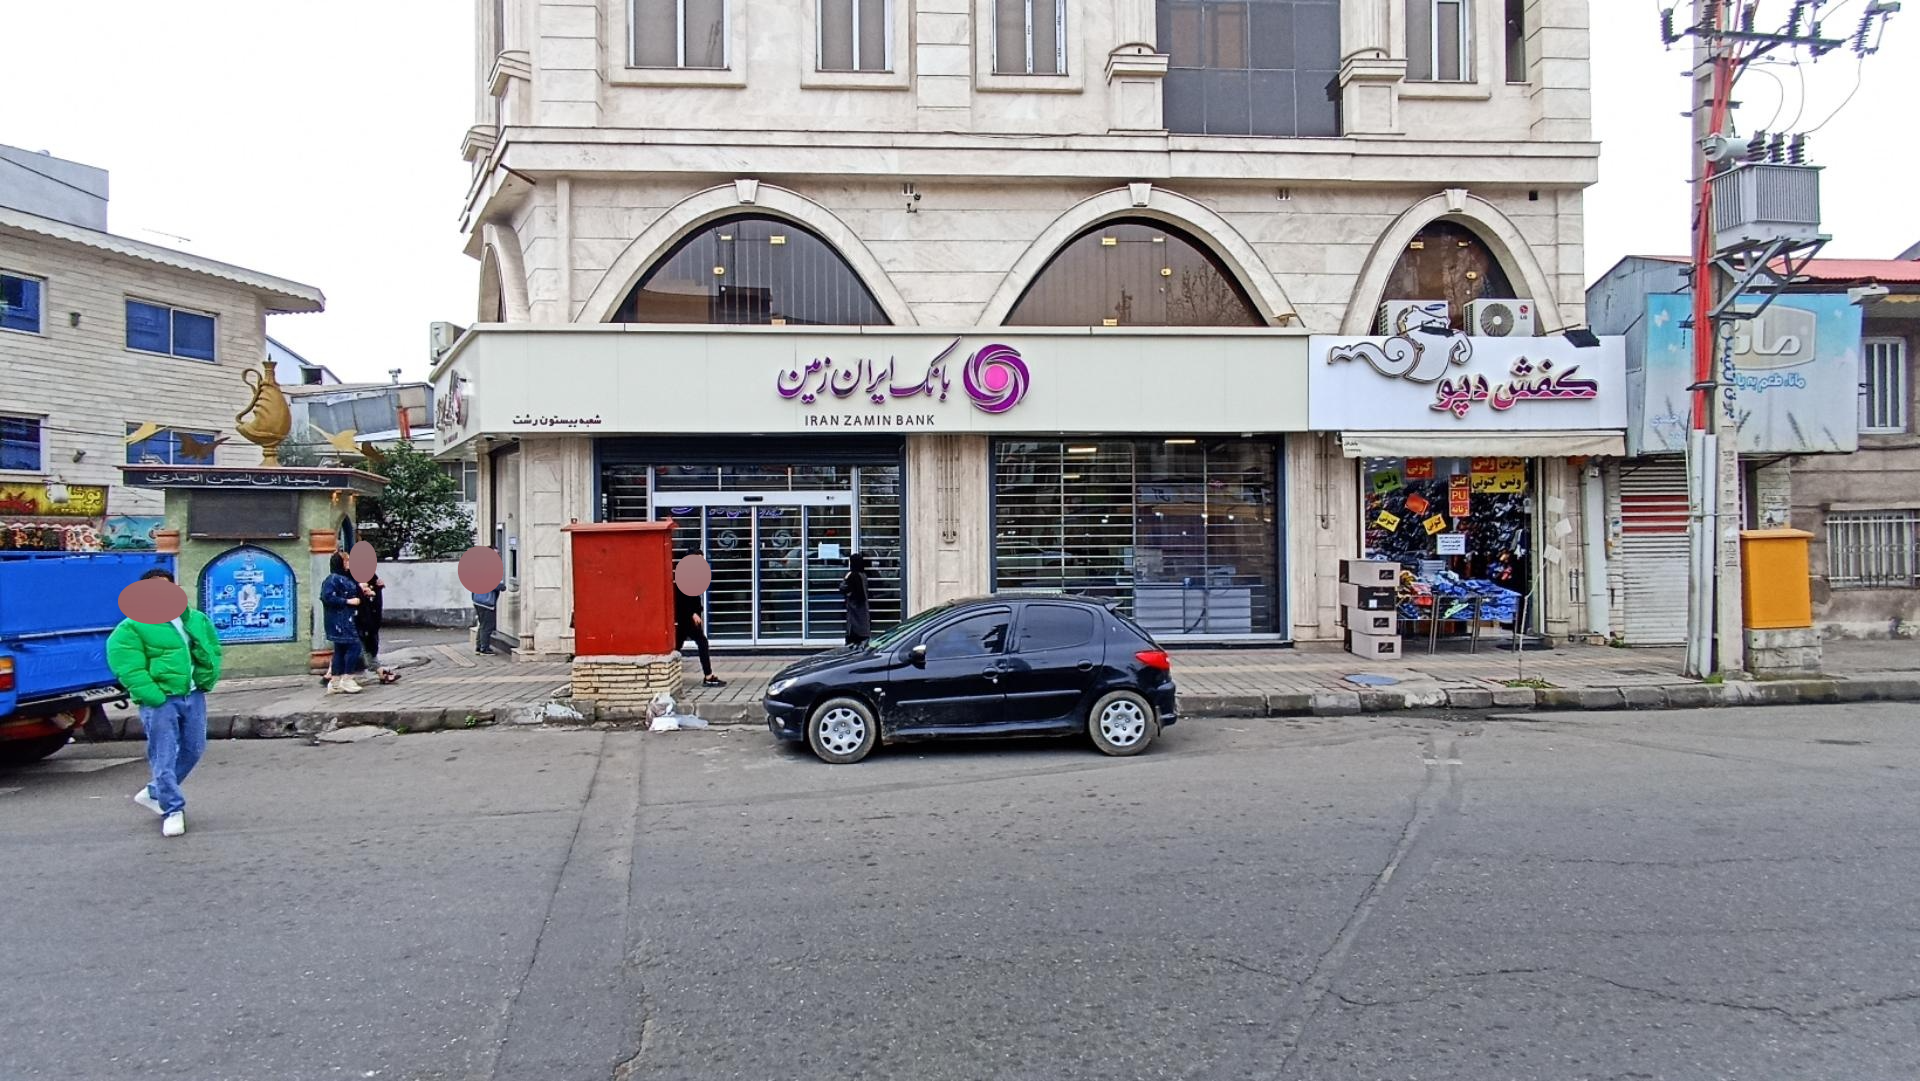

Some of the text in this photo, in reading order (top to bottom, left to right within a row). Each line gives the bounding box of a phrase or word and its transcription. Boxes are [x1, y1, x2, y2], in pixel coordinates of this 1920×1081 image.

[777, 335, 961, 404] بانک ایران زمین
[1429, 356, 1598, 419] کفش دپو
[1757, 373, 1783, 393] طعم
[512, 414, 601, 428] شعبه بیستون رشت
[805, 414, 935, 426] IRAN ZAMIN BANK
[1473, 474, 1521, 489] ونس کتونی
[1452, 491, 1466, 500] PU
